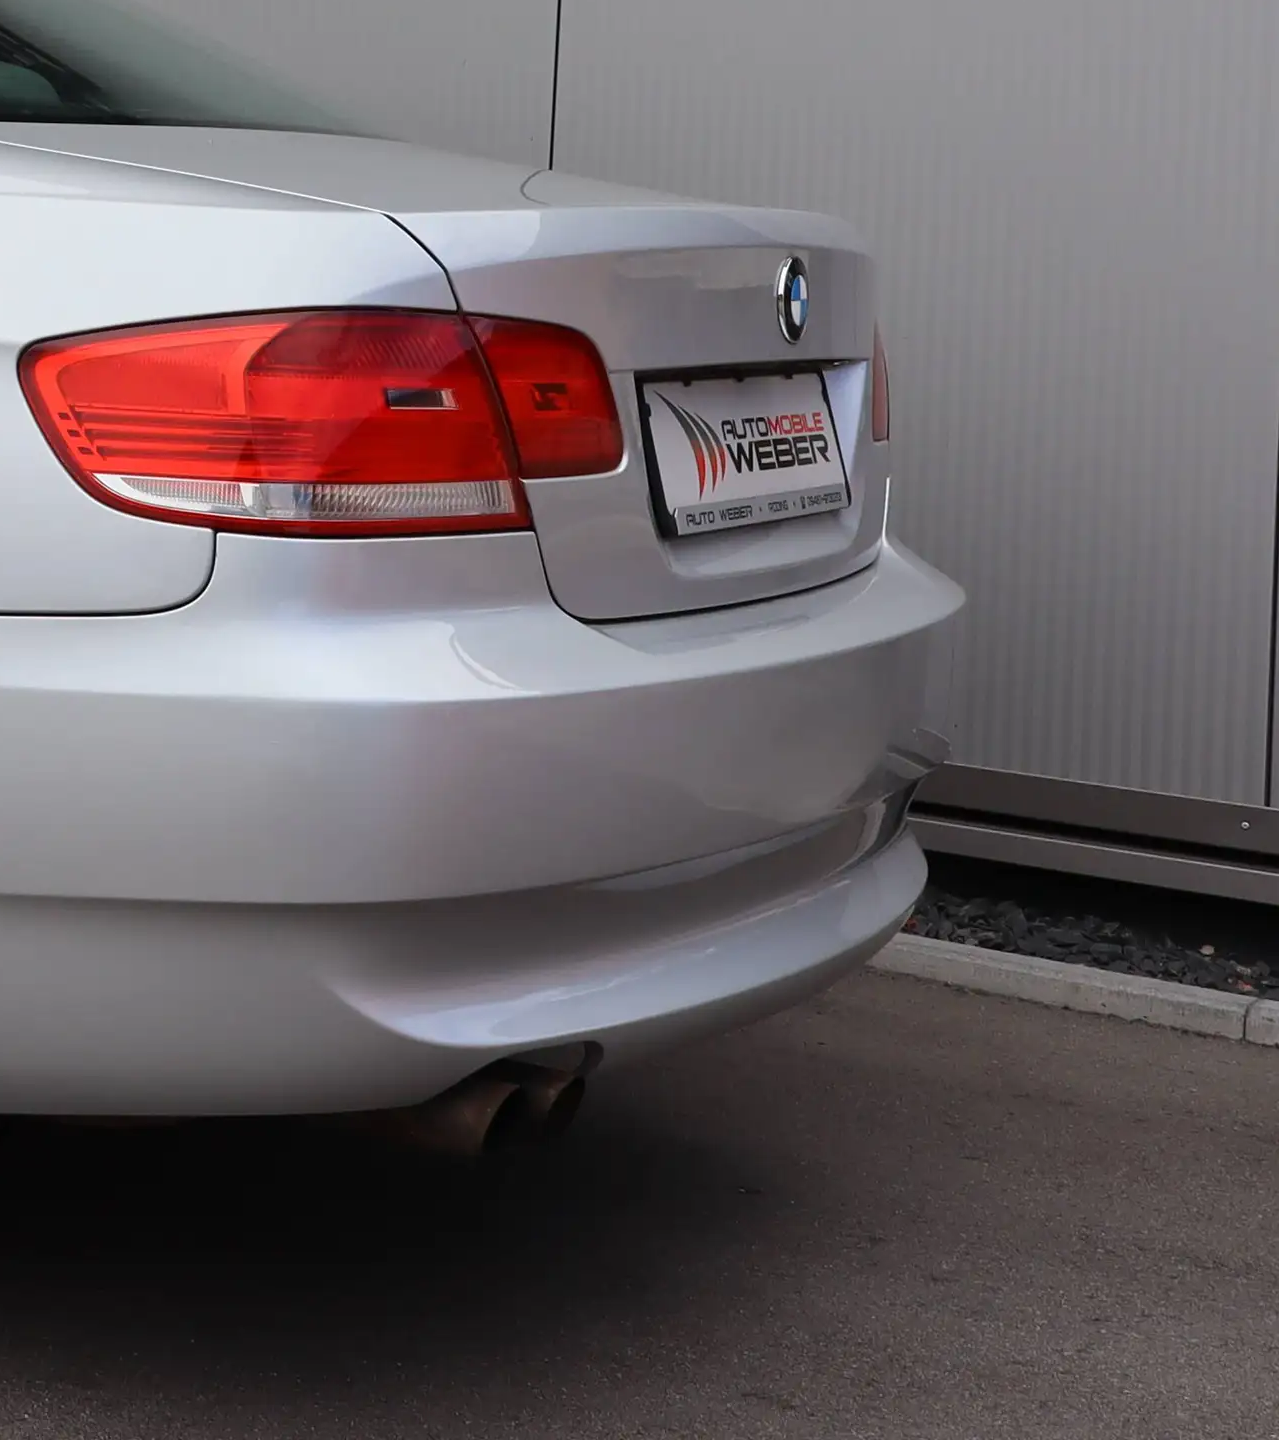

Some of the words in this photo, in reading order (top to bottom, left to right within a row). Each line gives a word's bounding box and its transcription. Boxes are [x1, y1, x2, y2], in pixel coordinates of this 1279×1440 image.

[721, 412, 825, 441] AUTOMOBILE
[725, 434, 831, 474] WEBER
[686, 511, 715, 527] AUTO
[719, 505, 753, 521] WEBER
